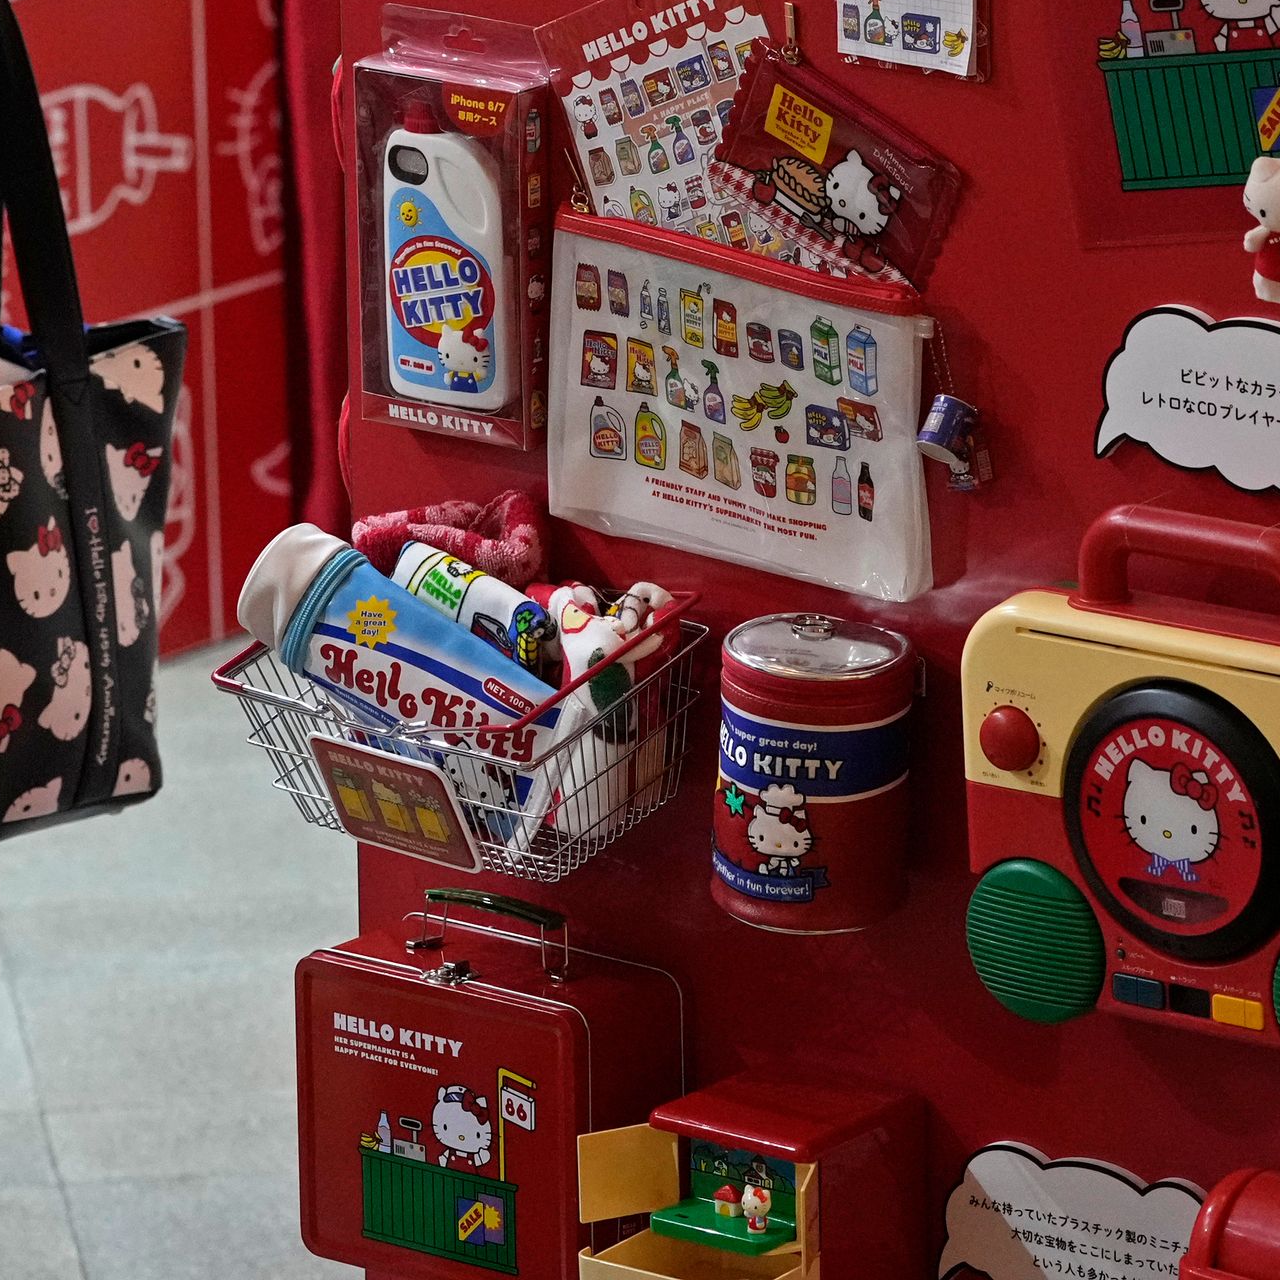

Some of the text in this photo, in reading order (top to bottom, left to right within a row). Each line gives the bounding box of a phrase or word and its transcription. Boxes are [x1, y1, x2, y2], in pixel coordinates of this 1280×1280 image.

[582, 21, 648, 62] HELLO
[450, 93, 505, 113] iPhone 8/7
[659, 92, 710, 118] HAPPY PLACE
[780, 91, 823, 128] Hello
[458, 110, 497, 126] 専用ケース
[775, 107, 821, 144] Kitty
[873, 148, 914, 194] Delicious!
[393, 258, 480, 297] HELLO
[401, 288, 485, 328] KITTY
[585, 340, 607, 351] Hello
[629, 347, 647, 358] Hello
[814, 347, 828, 362] MILK
[848, 357, 864, 372] MILK
[389, 404, 494, 436] HELLO KITTY
[807, 411, 826, 421] HELLO
[595, 432, 618, 441] HELLO
[596, 439, 620, 447] KITTY
[639, 440, 659, 449] HELLO
[641, 447, 659, 455] KITTY
[651, 477, 683, 492] FRIENDLY
[685, 487, 706, 498] STAFF
[708, 493, 721, 502] AND
[723, 497, 747, 510] YUMMY
[749, 506, 765, 517] STUFF
[767, 512, 786, 523] MAKE
[788, 518, 827, 531] SHOPPING
[652, 490, 661, 498] AT
[662, 493, 684, 504] HELLO
[686, 497, 714, 512] KITTY'S
[715, 507, 762, 528] SUPERMARKET
[763, 521, 776, 533] THE
[777, 527, 798, 538] MOST
[799, 531, 818, 542] FUN.
[422, 579, 458, 610] KITTY
[428, 568, 462, 600] HELLO
[361, 610, 383, 619] Have
[363, 619, 387, 628] great
[361, 627, 379, 637] day!
[320, 643, 418, 719] Hello
[486, 681, 532, 714] NET. 100 g
[421, 687, 538, 763] Kitty
[735, 727, 817, 753] super great day!
[328, 751, 424, 786] HELLO KITTY
[753, 753, 843, 780] KITTY
[1094, 725, 1247, 803] HELLO KITTY
[737, 873, 809, 896] in fun forever!
[333, 1012, 463, 1058] HELLO KITTY
[334, 1035, 415, 1061] HER SUPERMARKET IS A
[334, 1045, 438, 1076] HAPPY PLACE FOR EVERYONE!
[505, 1098, 527, 1122] 86
[460, 1208, 482, 1233] SALE
